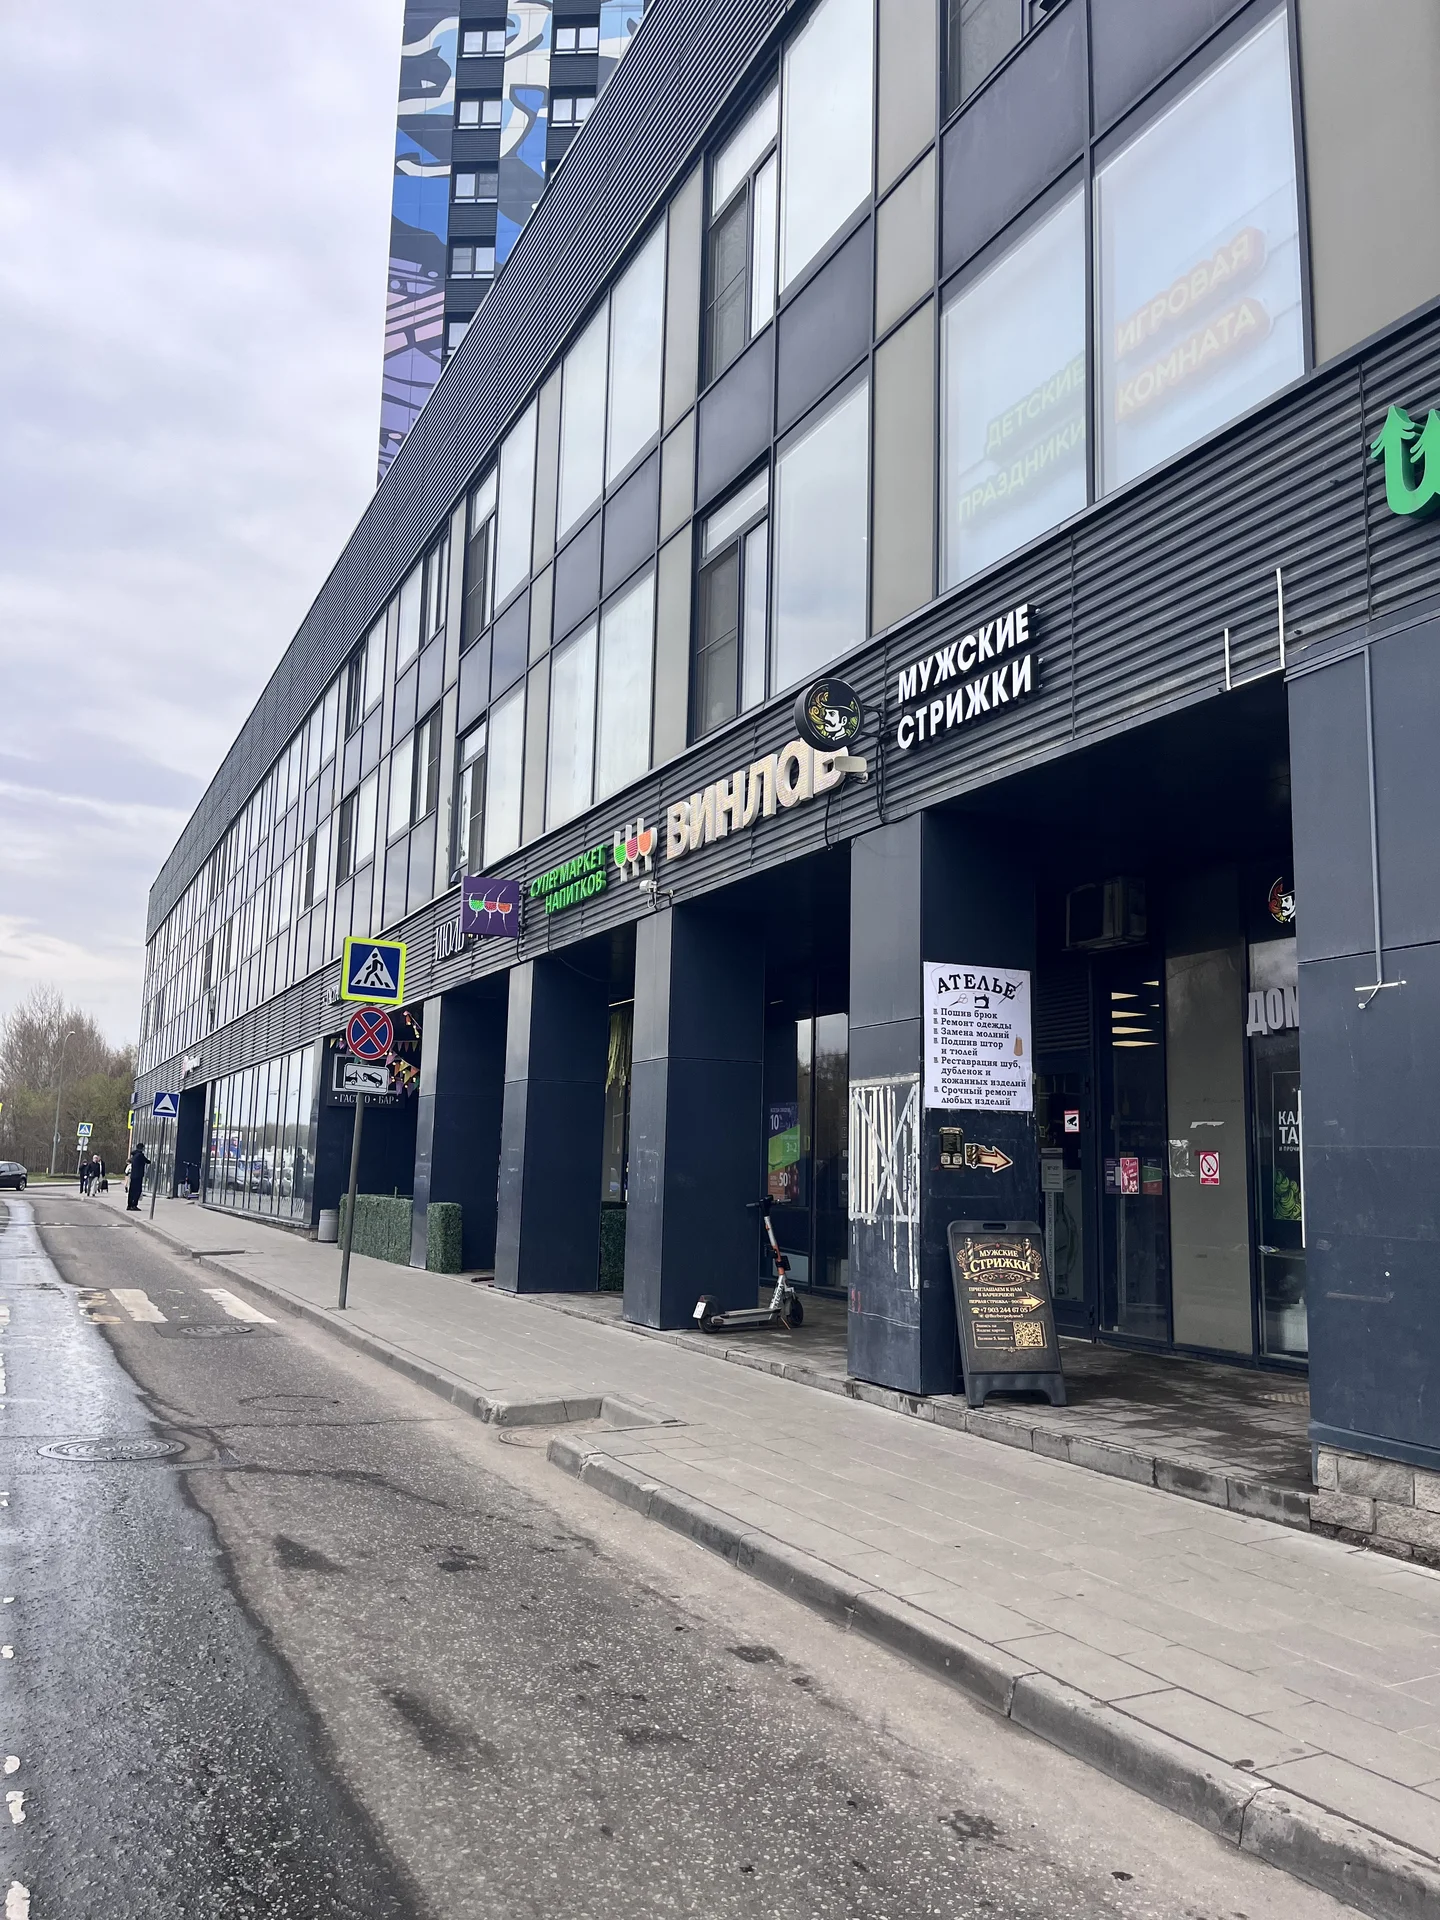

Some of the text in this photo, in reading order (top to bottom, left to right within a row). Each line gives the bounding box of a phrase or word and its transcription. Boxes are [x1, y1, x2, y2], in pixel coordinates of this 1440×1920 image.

[1117, 233, 1250, 354] ИГРОВАЯ
[1117, 302, 1256, 416] КОМНАТА
[986, 358, 1086, 455] ДЕТСКИЕ
[957, 413, 1086, 523] ПРАЗДНИКИ
[898, 603, 1030, 704] МУЖСКИЕ
[897, 654, 1033, 750] СТРИЖКИ
[530, 844, 608, 897] СУПЕРМАРКЕТ
[545, 870, 607, 915] НАПИТКОВ
[937, 974, 1017, 1000] АТЕЛЬЕ
[940, 1008, 998, 1020] Пошив брюк
[940, 1018, 1012, 1030] Ремонт одежды
[940, 1027, 1010, 1039] Замена молний
[940, 1037, 1004, 1050] Подшив штор
[949, 1047, 978, 1056] тюлей
[940, 1057, 1021, 1069] Реставрация шуб,
[940, 1067, 983, 1076] дубленок
[941, 1077, 1027, 1088] кожанных изделий
[941, 1086, 1017, 1097] Срочный ремонт
[339, 1094, 395, 1105] ГАСТО БАР
[941, 1096, 1011, 1106] любых изделий
[979, 1249, 1019, 1258] МУЖСКИЕ
[970, 1257, 1032, 1273] СТРИЖКИ
